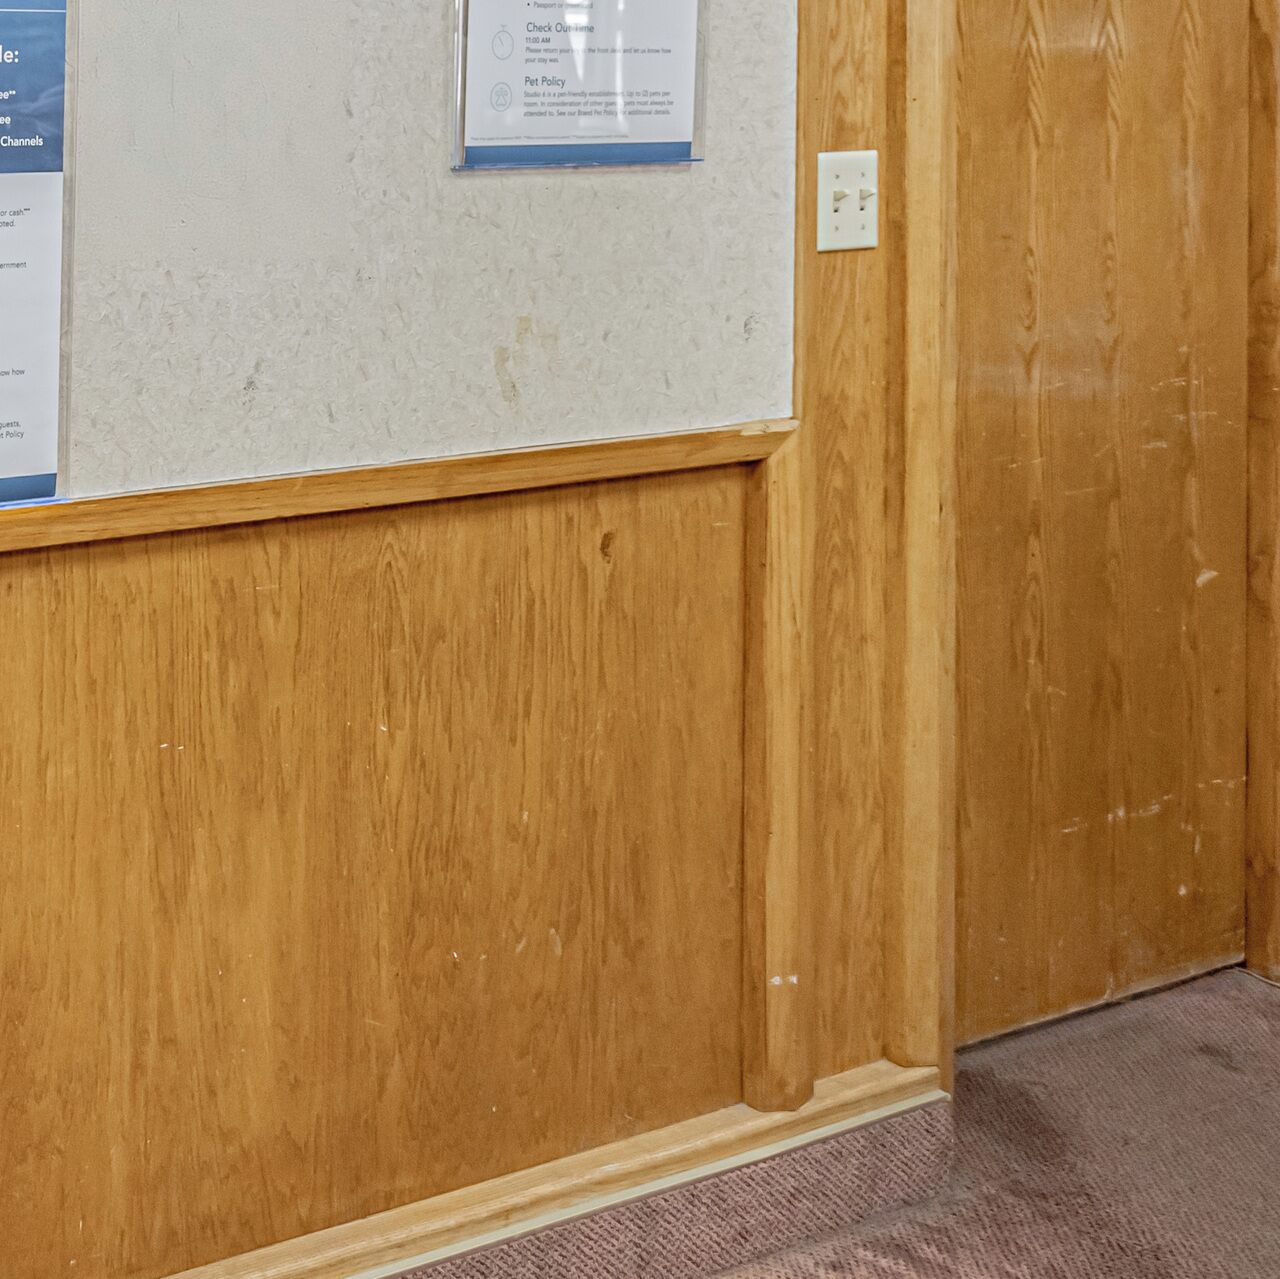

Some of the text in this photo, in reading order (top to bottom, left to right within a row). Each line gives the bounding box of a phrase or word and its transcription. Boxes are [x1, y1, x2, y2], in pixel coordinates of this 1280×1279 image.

[526, 22, 552, 32] Check
[555, 22, 571, 33] Out
[525, 76, 566, 88] Pet Policy
[0, 135, 44, 147] Channels
[0, 209, 7, 217] or
[11, 368, 25, 376] how
[5, 430, 24, 439] Policy
